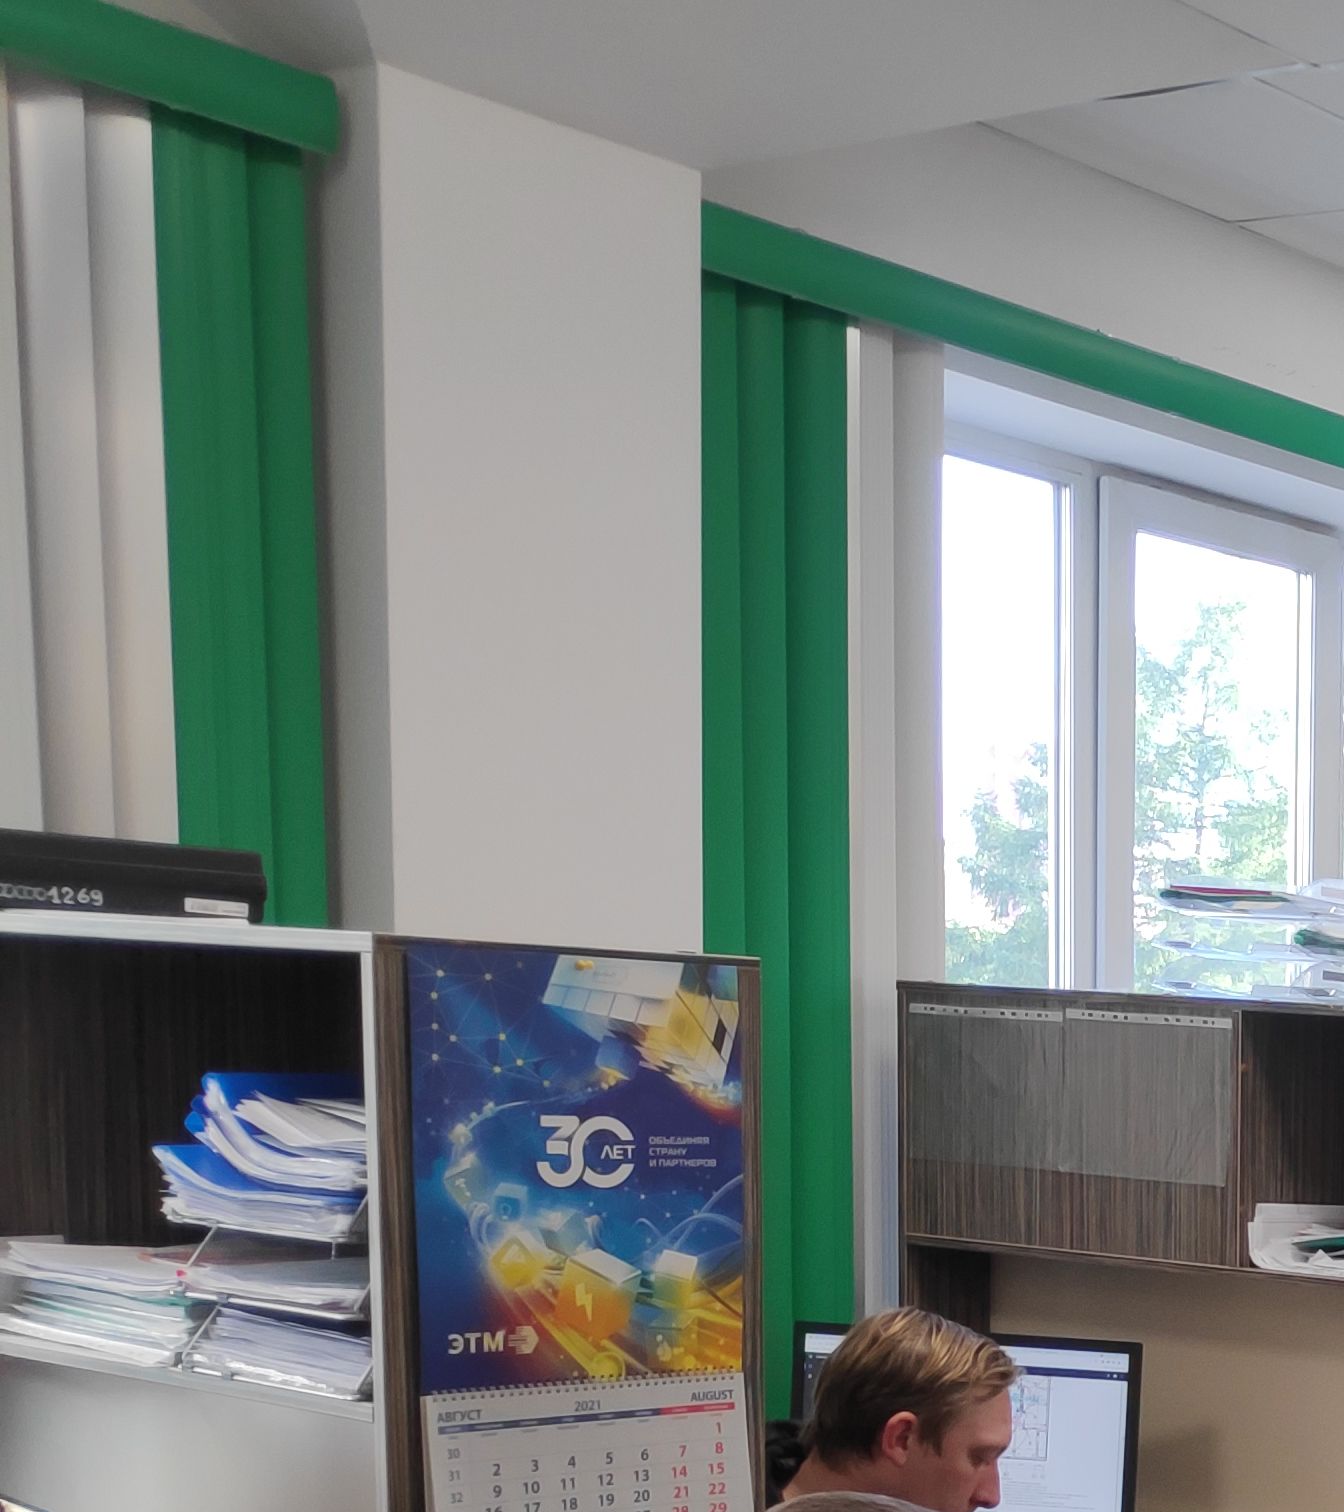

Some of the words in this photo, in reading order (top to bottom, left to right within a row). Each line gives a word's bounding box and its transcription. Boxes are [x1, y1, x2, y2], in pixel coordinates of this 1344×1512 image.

[447, 1330, 504, 1355] ЭТМ
[690, 1389, 734, 1402] AUGUST
[574, 1399, 601, 1412] 2021
[436, 1408, 483, 1424] АВГУСТ
[715, 1421, 722, 1434] 1
[678, 1444, 687, 1458] 7
[715, 1441, 724, 1455] 8
[492, 1463, 501, 1477] 2
[531, 1459, 539, 1473] 3
[567, 1455, 577, 1469] 4
[605, 1451, 614, 1465] 5
[640, 1448, 650, 1461] 6
[671, 1465, 688, 1479] 14
[708, 1461, 725, 1475] 15
[492, 1484, 503, 1499] 9
[522, 1480, 541, 1495] 10
[560, 1477, 576, 1491] 11
[597, 1472, 614, 1487] 12
[633, 1469, 650, 1483] 13
[673, 1485, 689, 1499] 21
[708, 1481, 726, 1496] 22
[561, 1497, 578, 1511] 18
[598, 1493, 615, 1507] 19
[633, 1489, 651, 1503] 20
